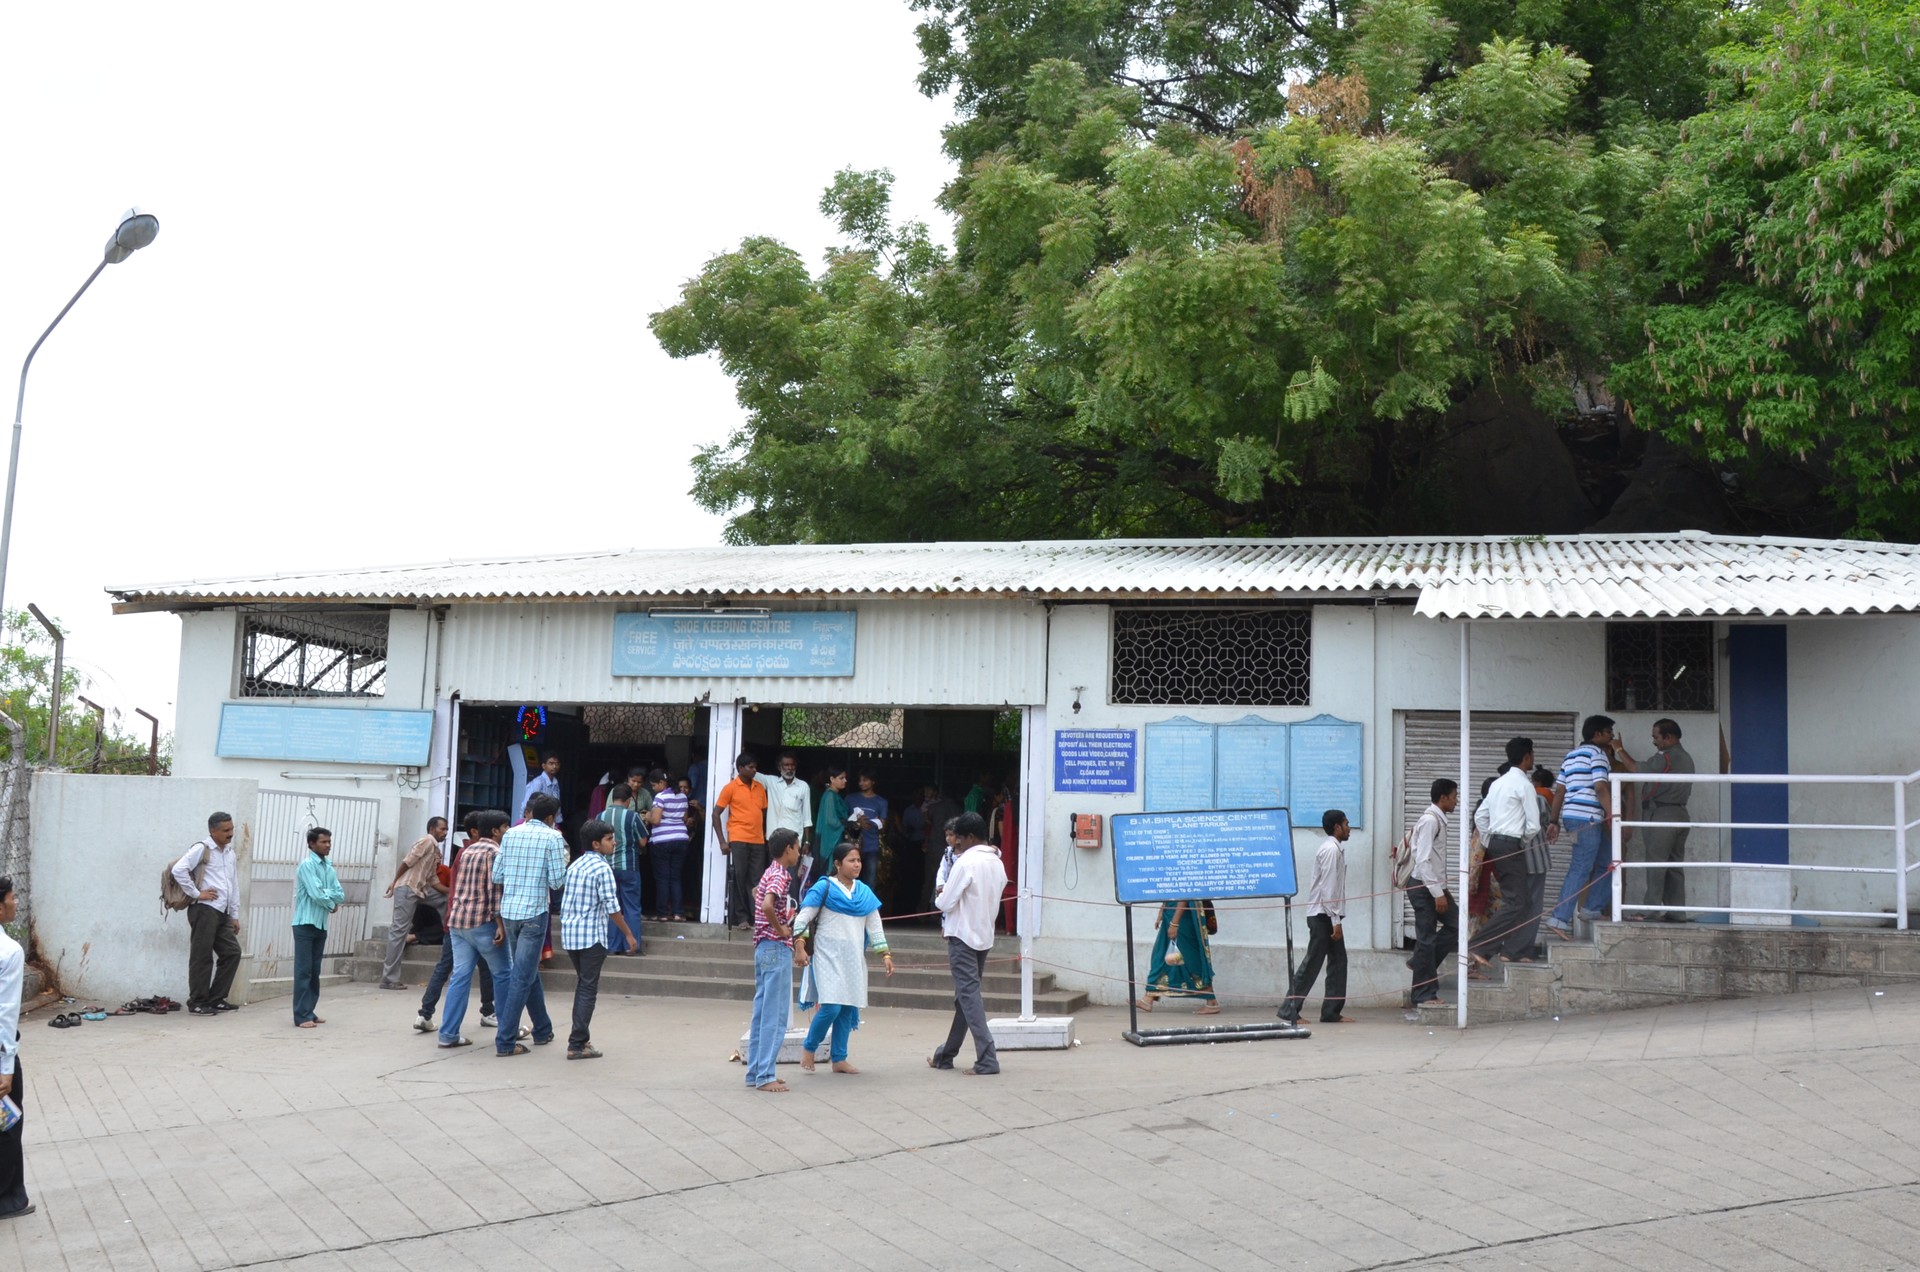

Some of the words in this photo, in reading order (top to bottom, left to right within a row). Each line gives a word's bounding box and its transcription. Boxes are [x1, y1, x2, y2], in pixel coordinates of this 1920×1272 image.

[673, 620, 700, 633] SHOE
[703, 620, 747, 633] KEEPING
[750, 620, 791, 633] CENTRE
[628, 631, 658, 644] FREE
[627, 646, 657, 655] SERVICE
[1185, 815, 1224, 823] SCIENCE
[1156, 881, 1179, 889] NIRMALA
